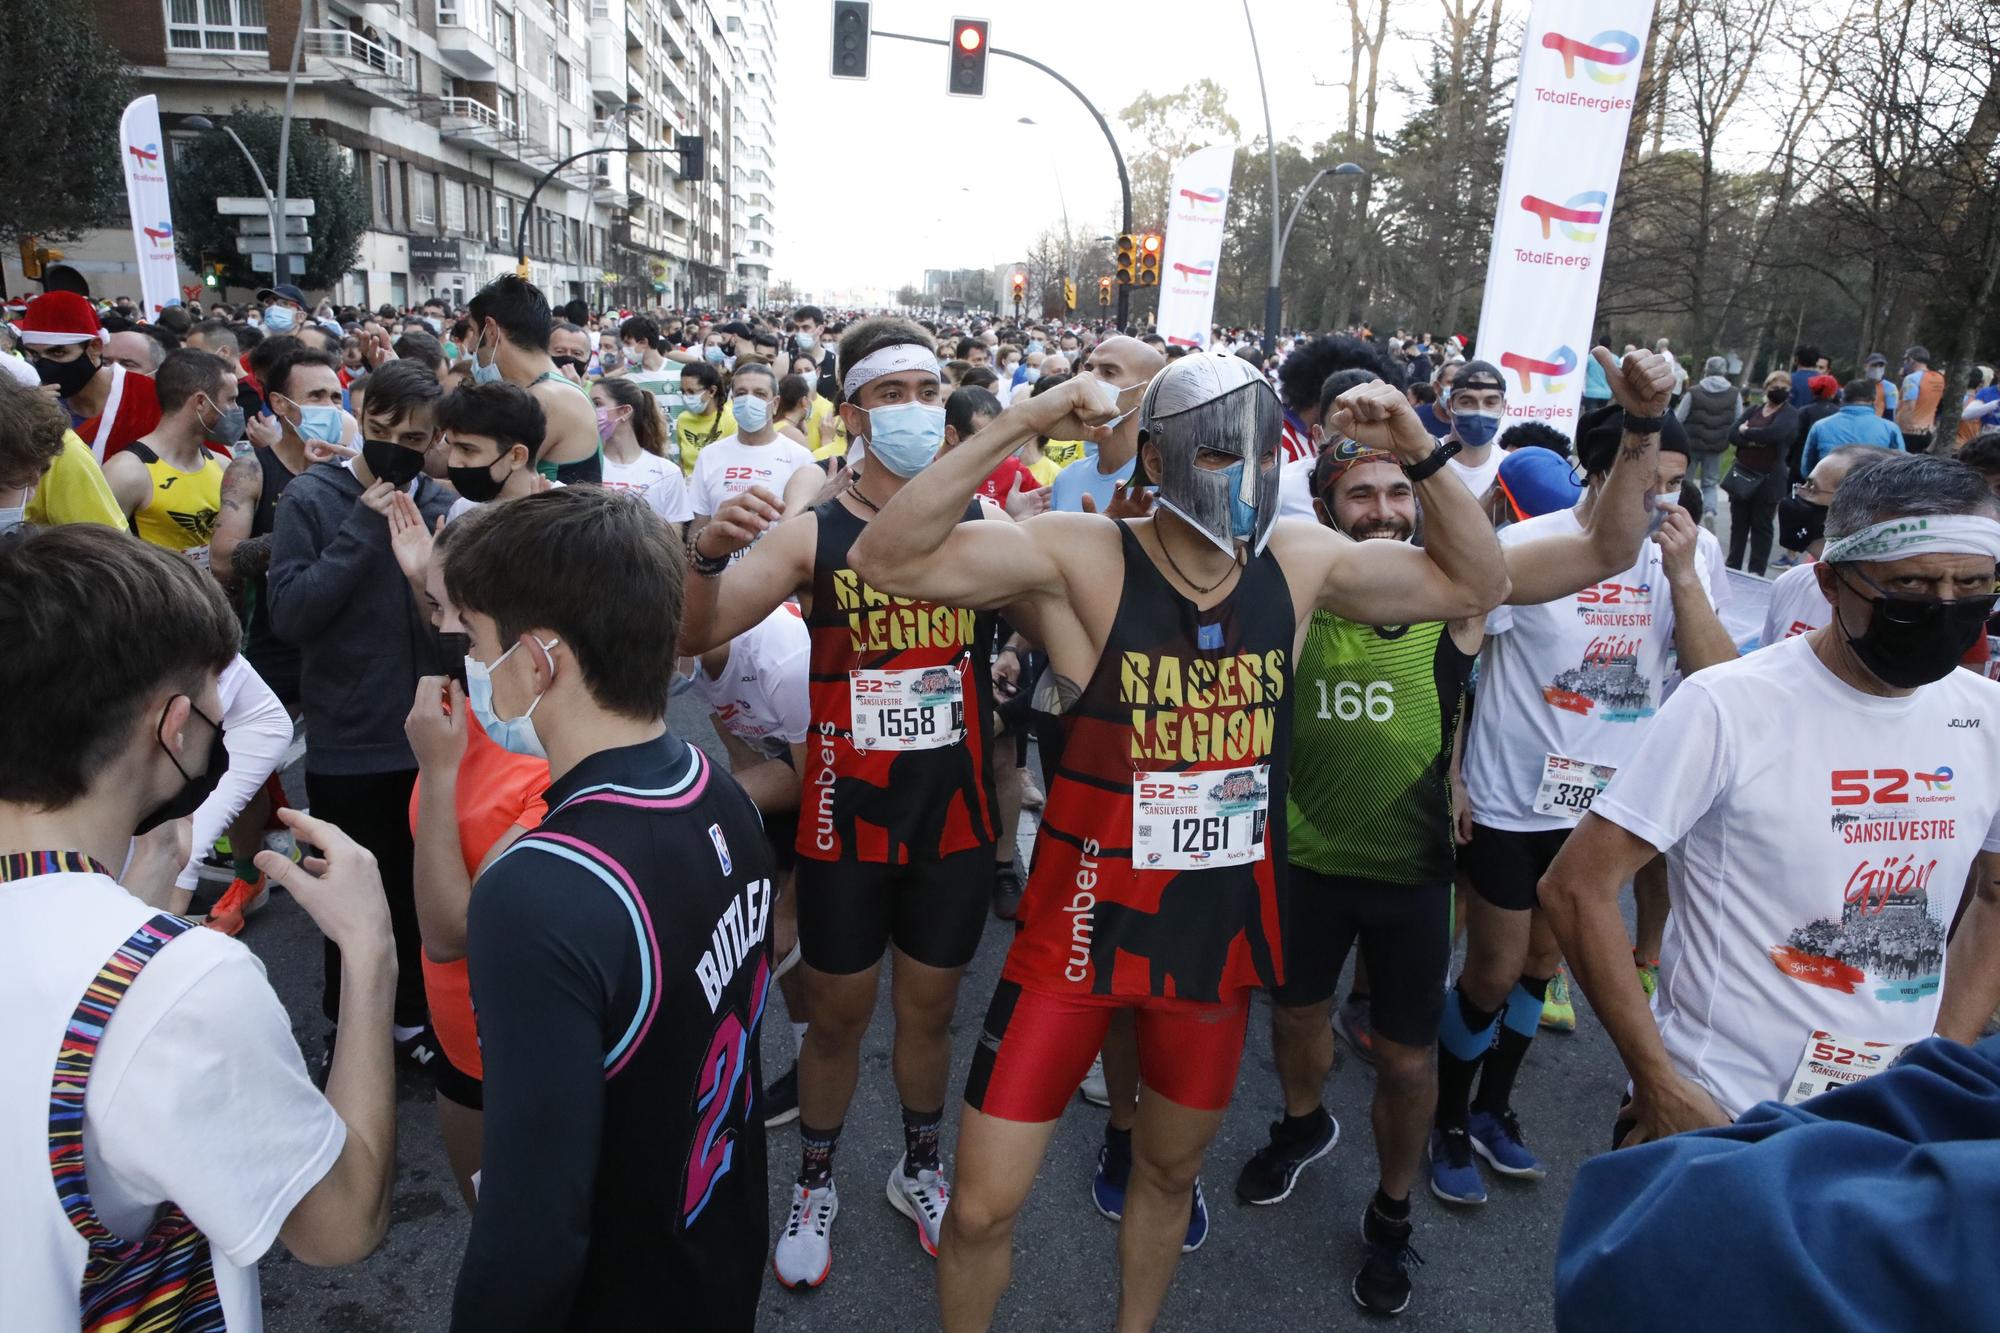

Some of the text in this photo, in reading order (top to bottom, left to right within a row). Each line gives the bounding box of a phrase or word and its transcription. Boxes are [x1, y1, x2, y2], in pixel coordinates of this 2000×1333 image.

[1536, 88, 1632, 112] TotalEnergies
[725, 467, 752, 479] 52
[1577, 583, 1622, 604] 52
[848, 605, 976, 652] LEGION
[1584, 614, 1652, 627] SANSILVESTRE
[855, 680, 882, 692] 52
[1119, 649, 1285, 709] RACERS
[860, 698, 902, 706] SANSILVESTRE
[1315, 679, 1394, 722] 166
[878, 706, 935, 737] 1558
[1131, 707, 1275, 762] LEGION
[1548, 756, 1570, 770] 52
[815, 721, 837, 851] cumbers
[1140, 784, 1175, 799] 52
[1553, 782, 1604, 809] 338
[1831, 768, 1909, 806] 52
[1144, 805, 1198, 815] SANSILVESTRE
[1916, 795, 1955, 804] TotalEnergies
[1172, 816, 1230, 852] 1261
[1844, 819, 1956, 844] SANSILVESTRE
[1844, 854, 1938, 917] Gijón
[1062, 837, 1100, 982] cumbers
[695, 878, 771, 1014] BUTLER
[1812, 1043, 1856, 1065] 52
